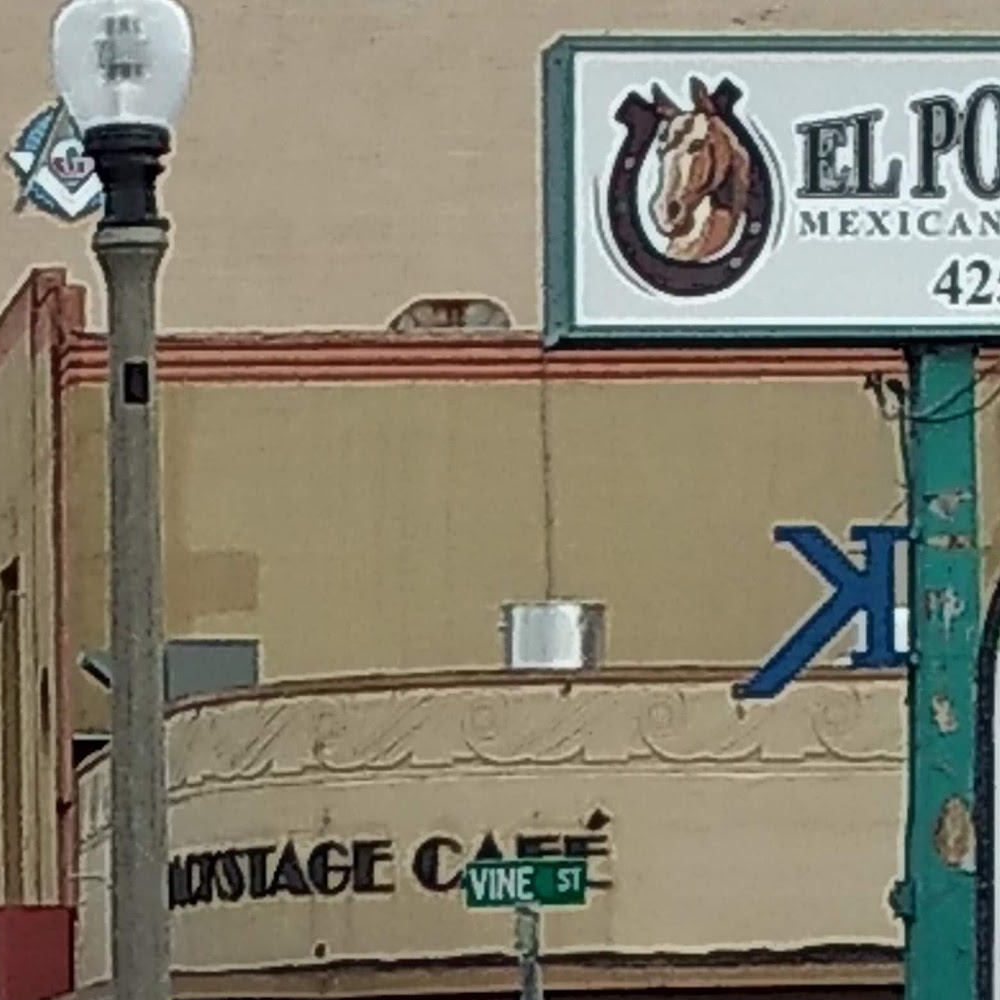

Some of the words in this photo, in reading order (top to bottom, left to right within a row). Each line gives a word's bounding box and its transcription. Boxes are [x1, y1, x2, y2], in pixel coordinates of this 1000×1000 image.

[796, 108, 901, 199] EL
[799, 210, 1000, 237] MEXICAN
[933, 259, 1000, 305] 42
[469, 865, 535, 901] VINE
[557, 867, 583, 893] ST
